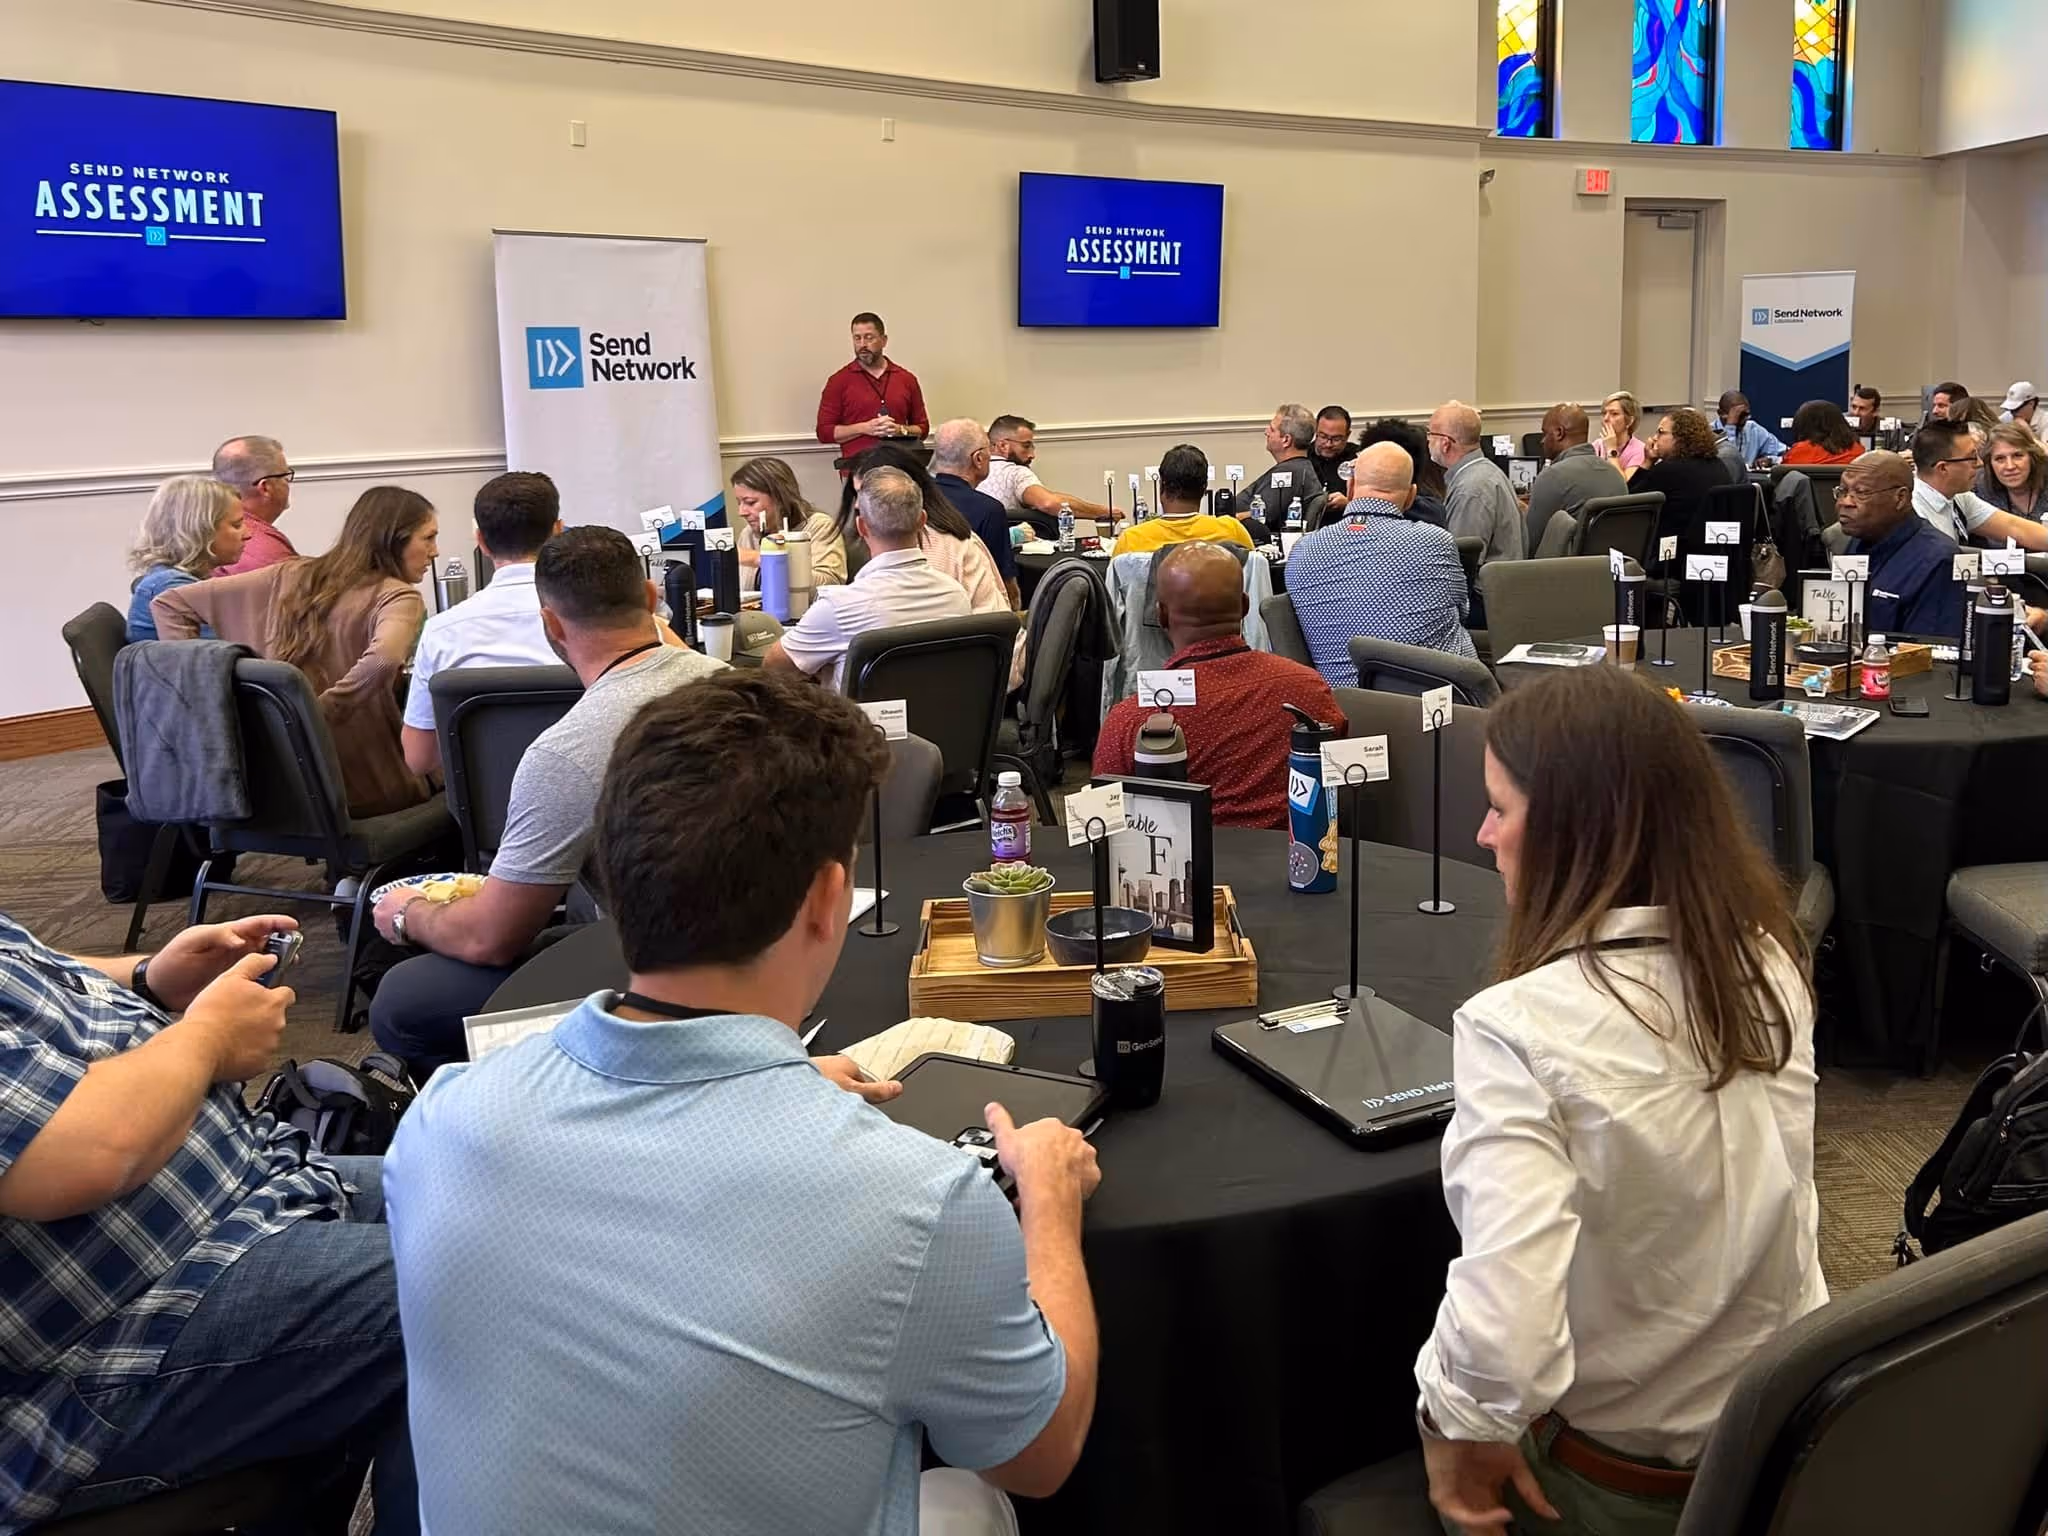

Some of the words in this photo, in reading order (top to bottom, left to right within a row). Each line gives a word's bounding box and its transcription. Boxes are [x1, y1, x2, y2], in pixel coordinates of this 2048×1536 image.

[69, 163, 124, 177] SEND
[132, 167, 230, 184] NETWORK
[1586, 168, 1610, 193] EXIT
[35, 180, 264, 227] ASSESSMENT
[1085, 226, 1113, 236] SEND
[1116, 227, 1166, 238] NETWORK
[1066, 237, 1182, 266] ASSESSMENT
[1774, 309, 1799, 318] Send
[1800, 308, 1843, 318] Network
[589, 332, 651, 356] Send
[591, 356, 697, 382] Network
[1810, 588, 1838, 599] Table
[1825, 600, 1846, 622] E
[1965, 600, 1973, 631] Network
[1769, 621, 1777, 655] Network
[1964, 631, 1972, 650] Send
[1769, 655, 1777, 674] Send
[1145, 834, 1173, 876] F
[1384, 1088, 1425, 1103] SEND
